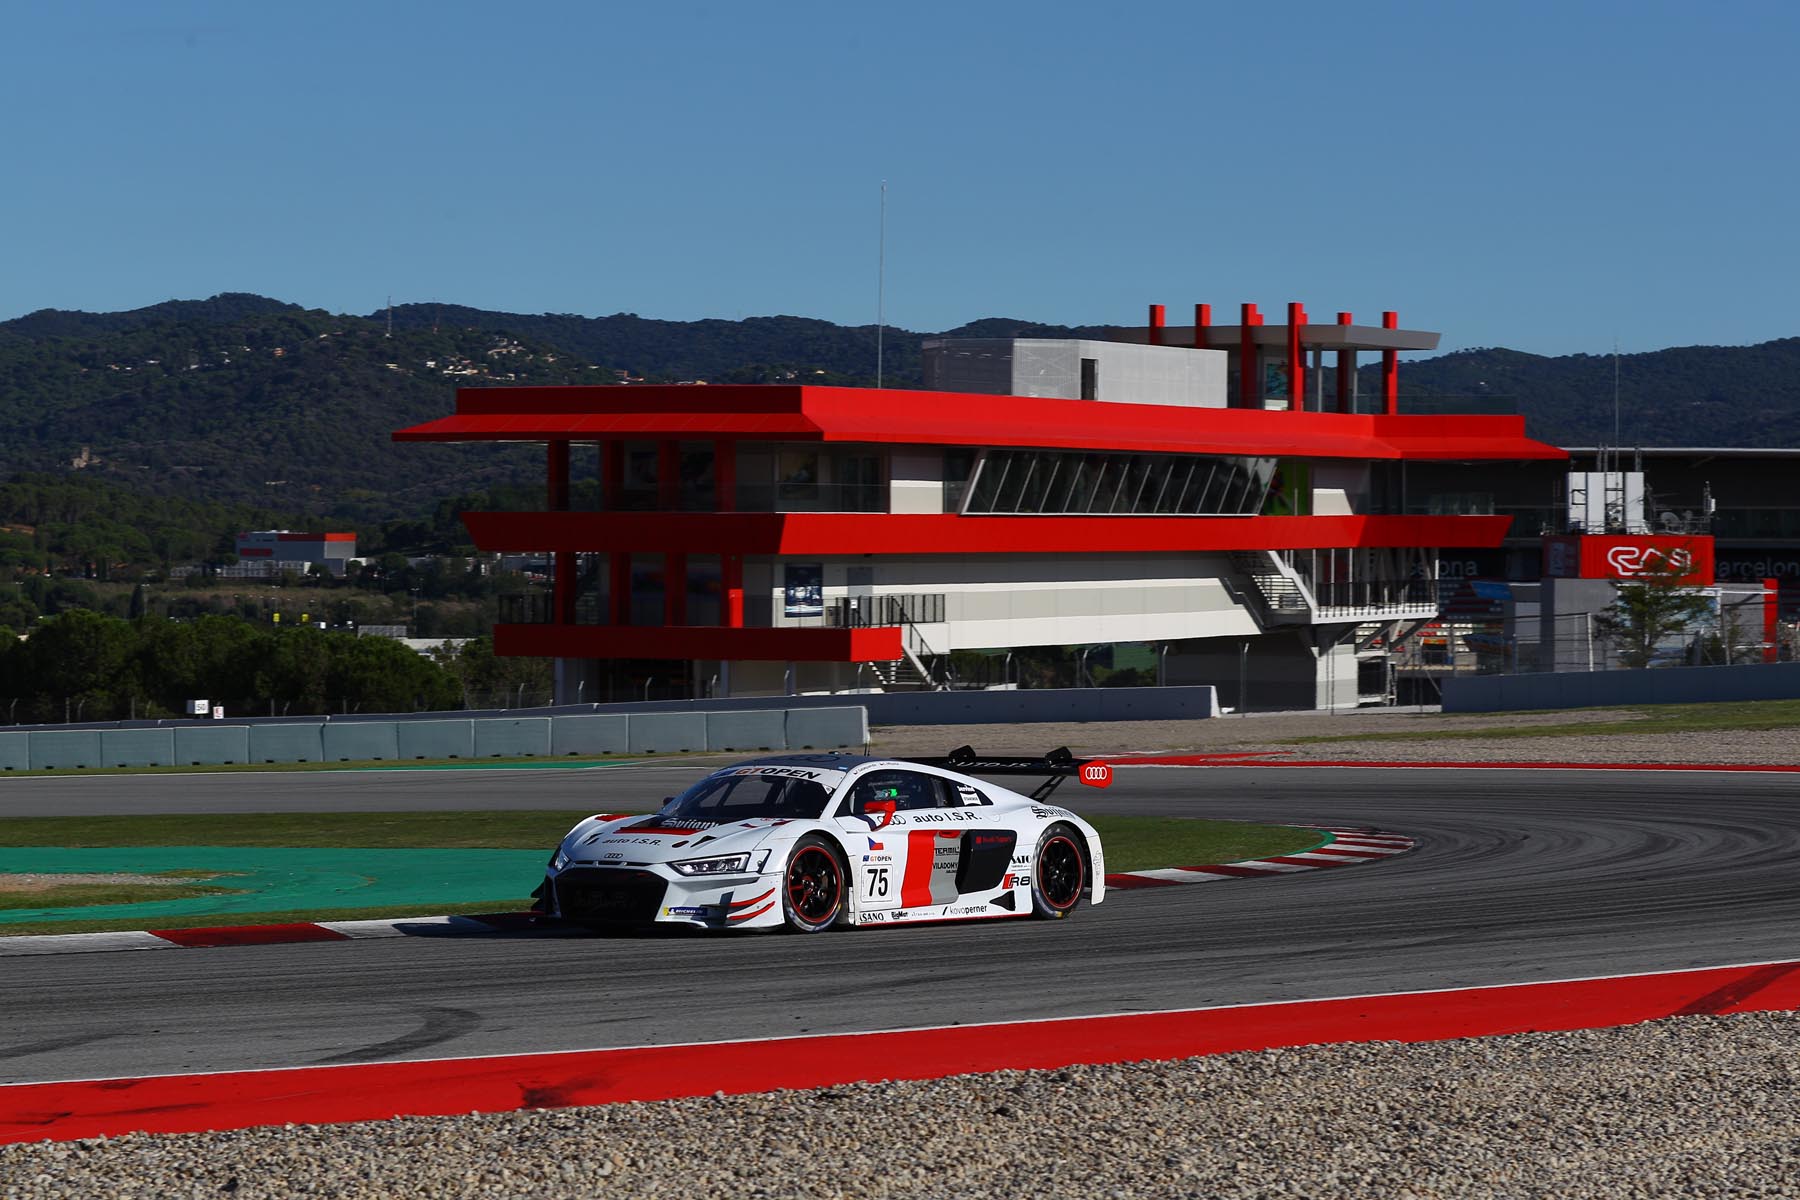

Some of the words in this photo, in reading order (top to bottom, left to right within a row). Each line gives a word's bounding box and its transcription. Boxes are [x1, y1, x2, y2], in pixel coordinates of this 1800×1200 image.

[1717, 556, 1800, 577] arcelon
[913, 814, 944, 823] auto
[944, 811, 983, 822] I.S.R.
[867, 868, 888, 897] 75
[950, 905, 987, 915] kovoperner
[860, 912, 885, 922] SANO
